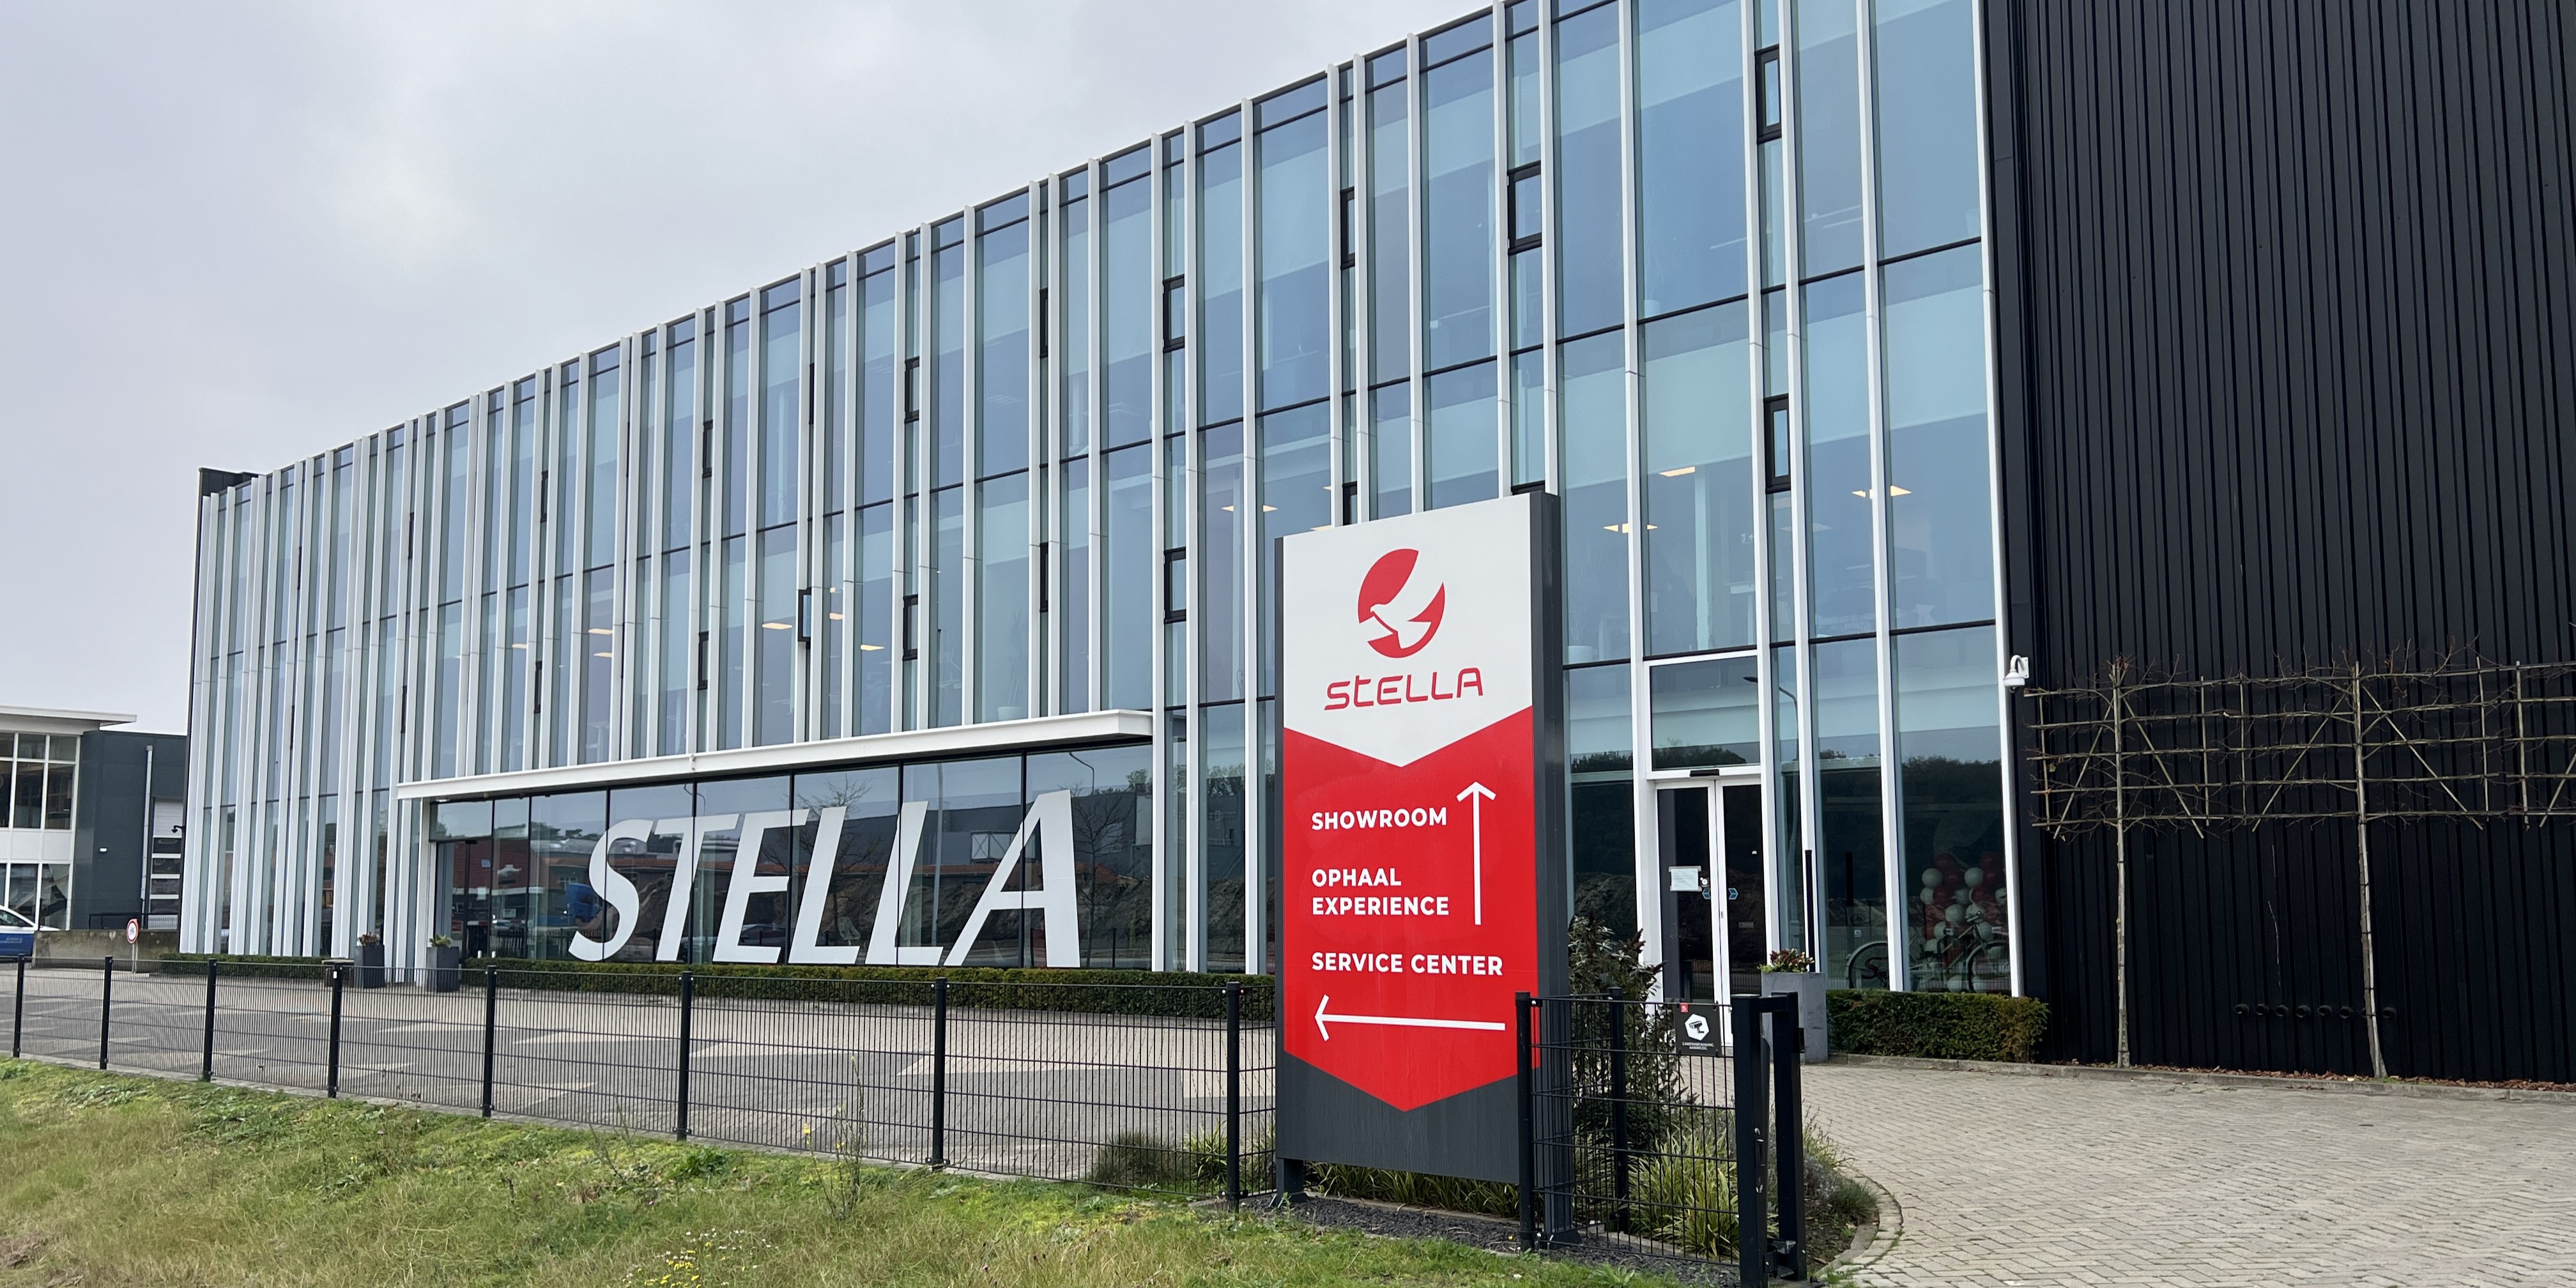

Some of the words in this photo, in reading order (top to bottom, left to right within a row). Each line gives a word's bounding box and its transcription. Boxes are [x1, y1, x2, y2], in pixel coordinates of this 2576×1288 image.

[1312, 807, 1446, 830] SHOWROOM
[568, 789, 1080, 968] STELLA
[1312, 868, 1402, 887] OPHAAL
[1312, 896, 1449, 916] EXPERIENCE
[1312, 952, 1403, 973] SERVICE
[1411, 954, 1503, 976] CENTER
